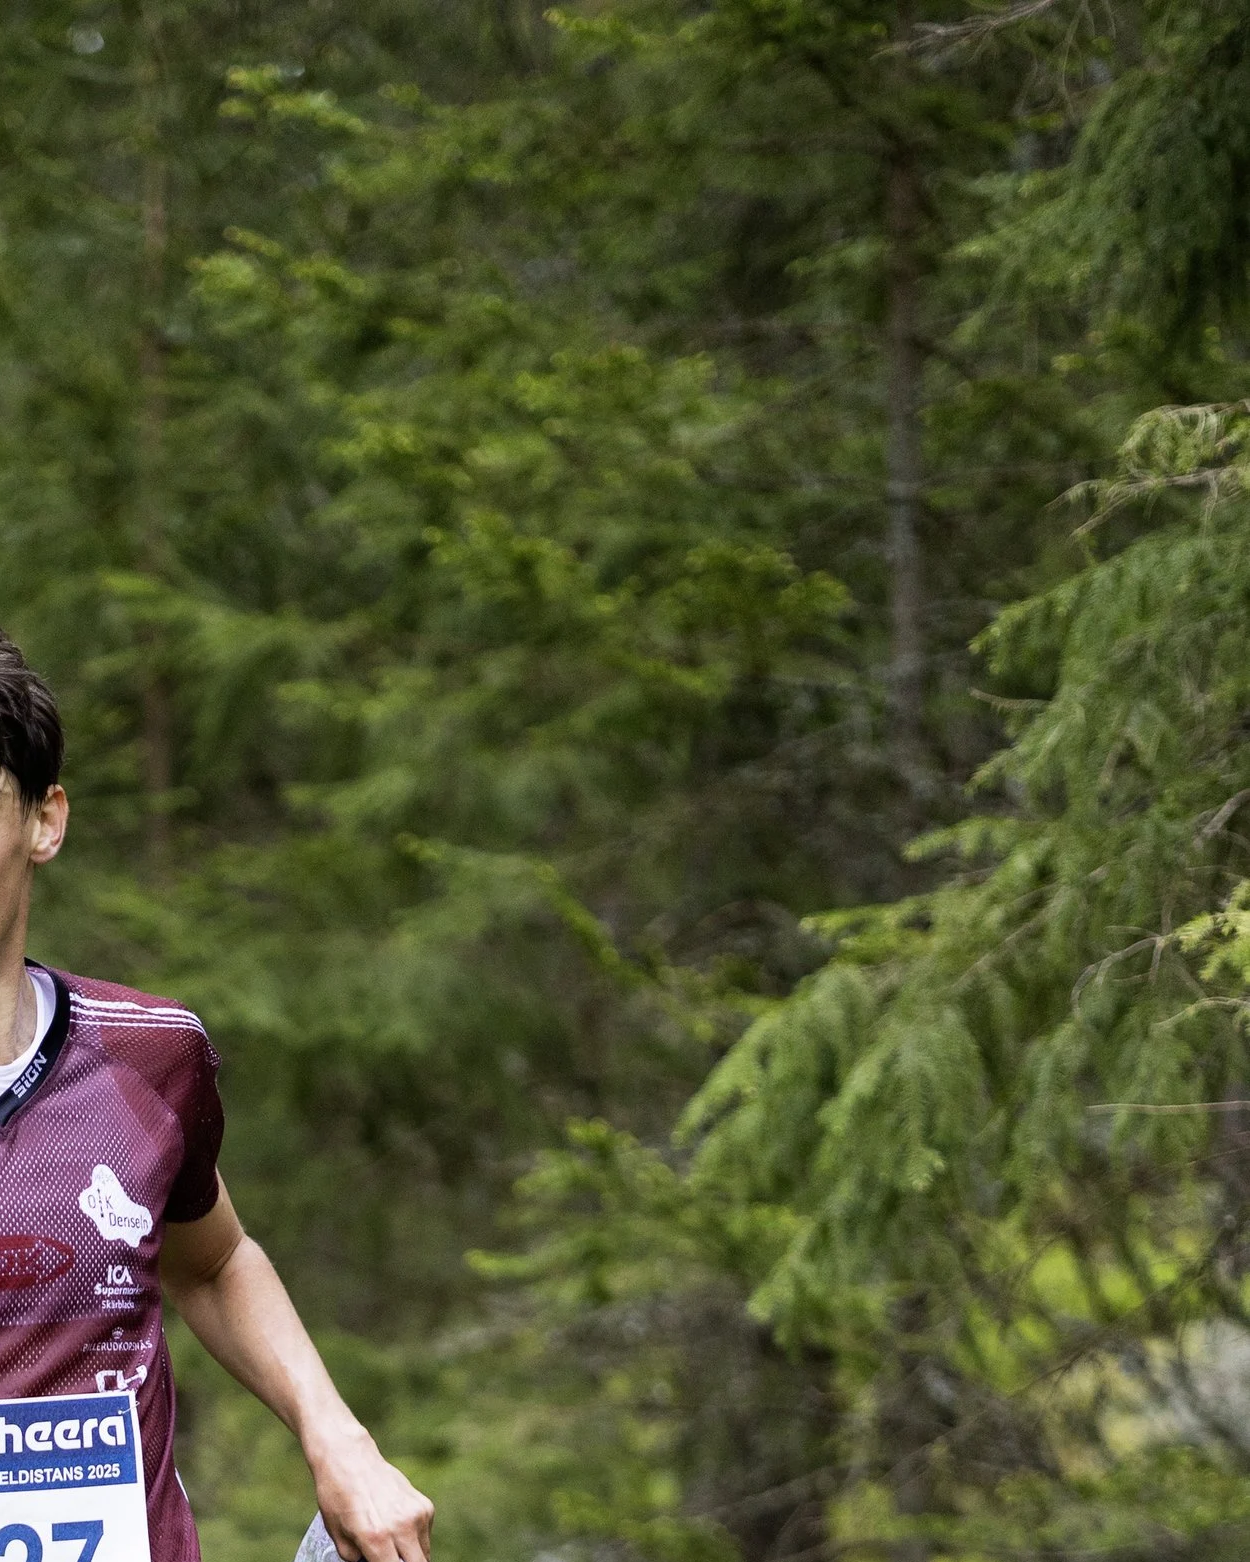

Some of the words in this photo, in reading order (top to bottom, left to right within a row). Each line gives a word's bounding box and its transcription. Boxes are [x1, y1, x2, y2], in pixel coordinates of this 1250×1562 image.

[109, 1212, 149, 1231] Denseln
[106, 1264, 134, 1285] ICA
[87, 1463, 121, 1480] 2025
